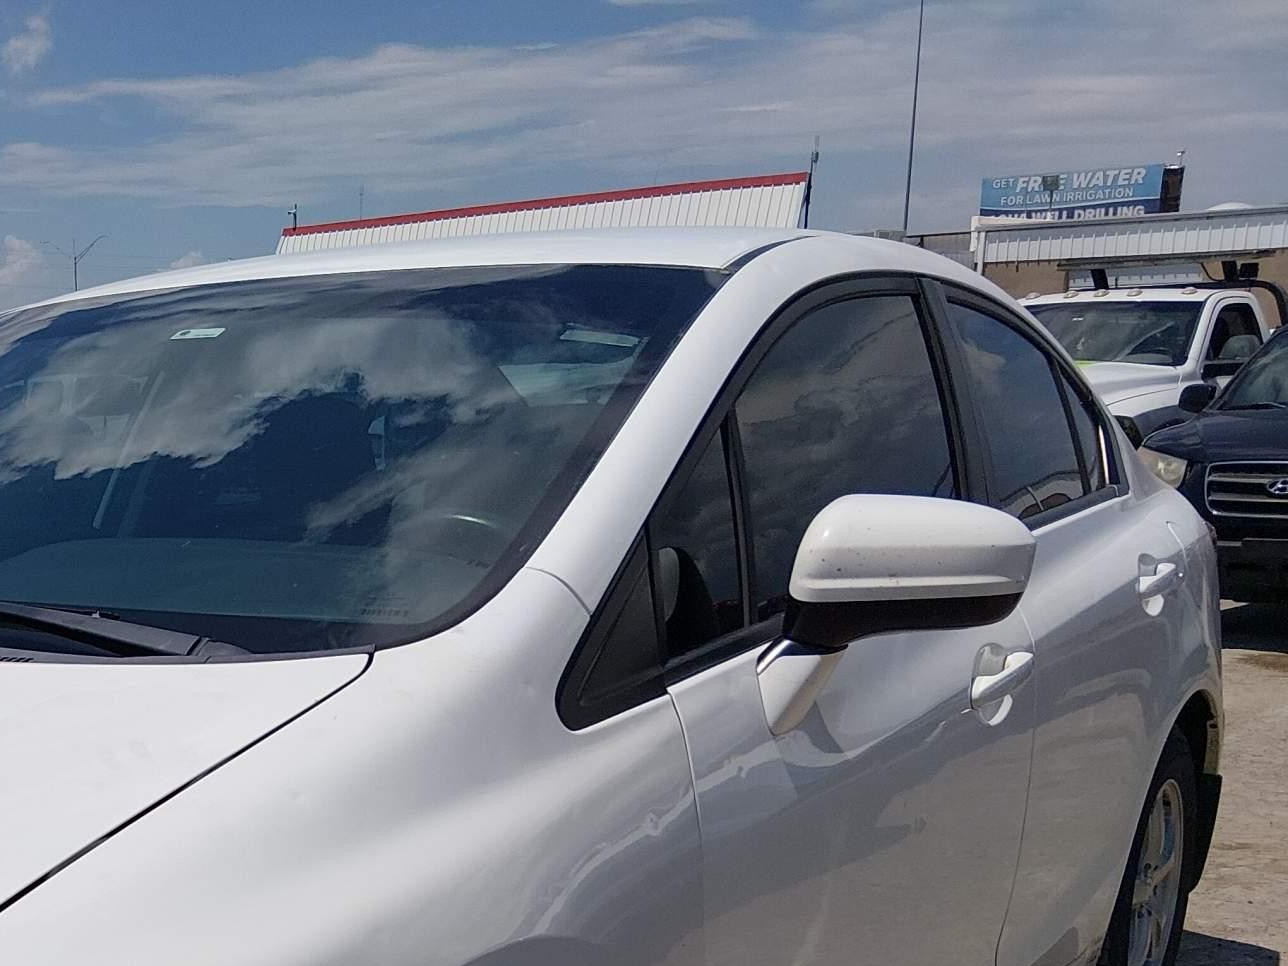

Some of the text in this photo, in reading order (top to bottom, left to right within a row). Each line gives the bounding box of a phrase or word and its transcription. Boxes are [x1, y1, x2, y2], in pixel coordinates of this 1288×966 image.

[993, 168, 1145, 192] GET FRE WATER
[1000, 188, 1133, 206] FOR LAWN IRRIGATION
[1073, 205, 1145, 220] DRILLING
